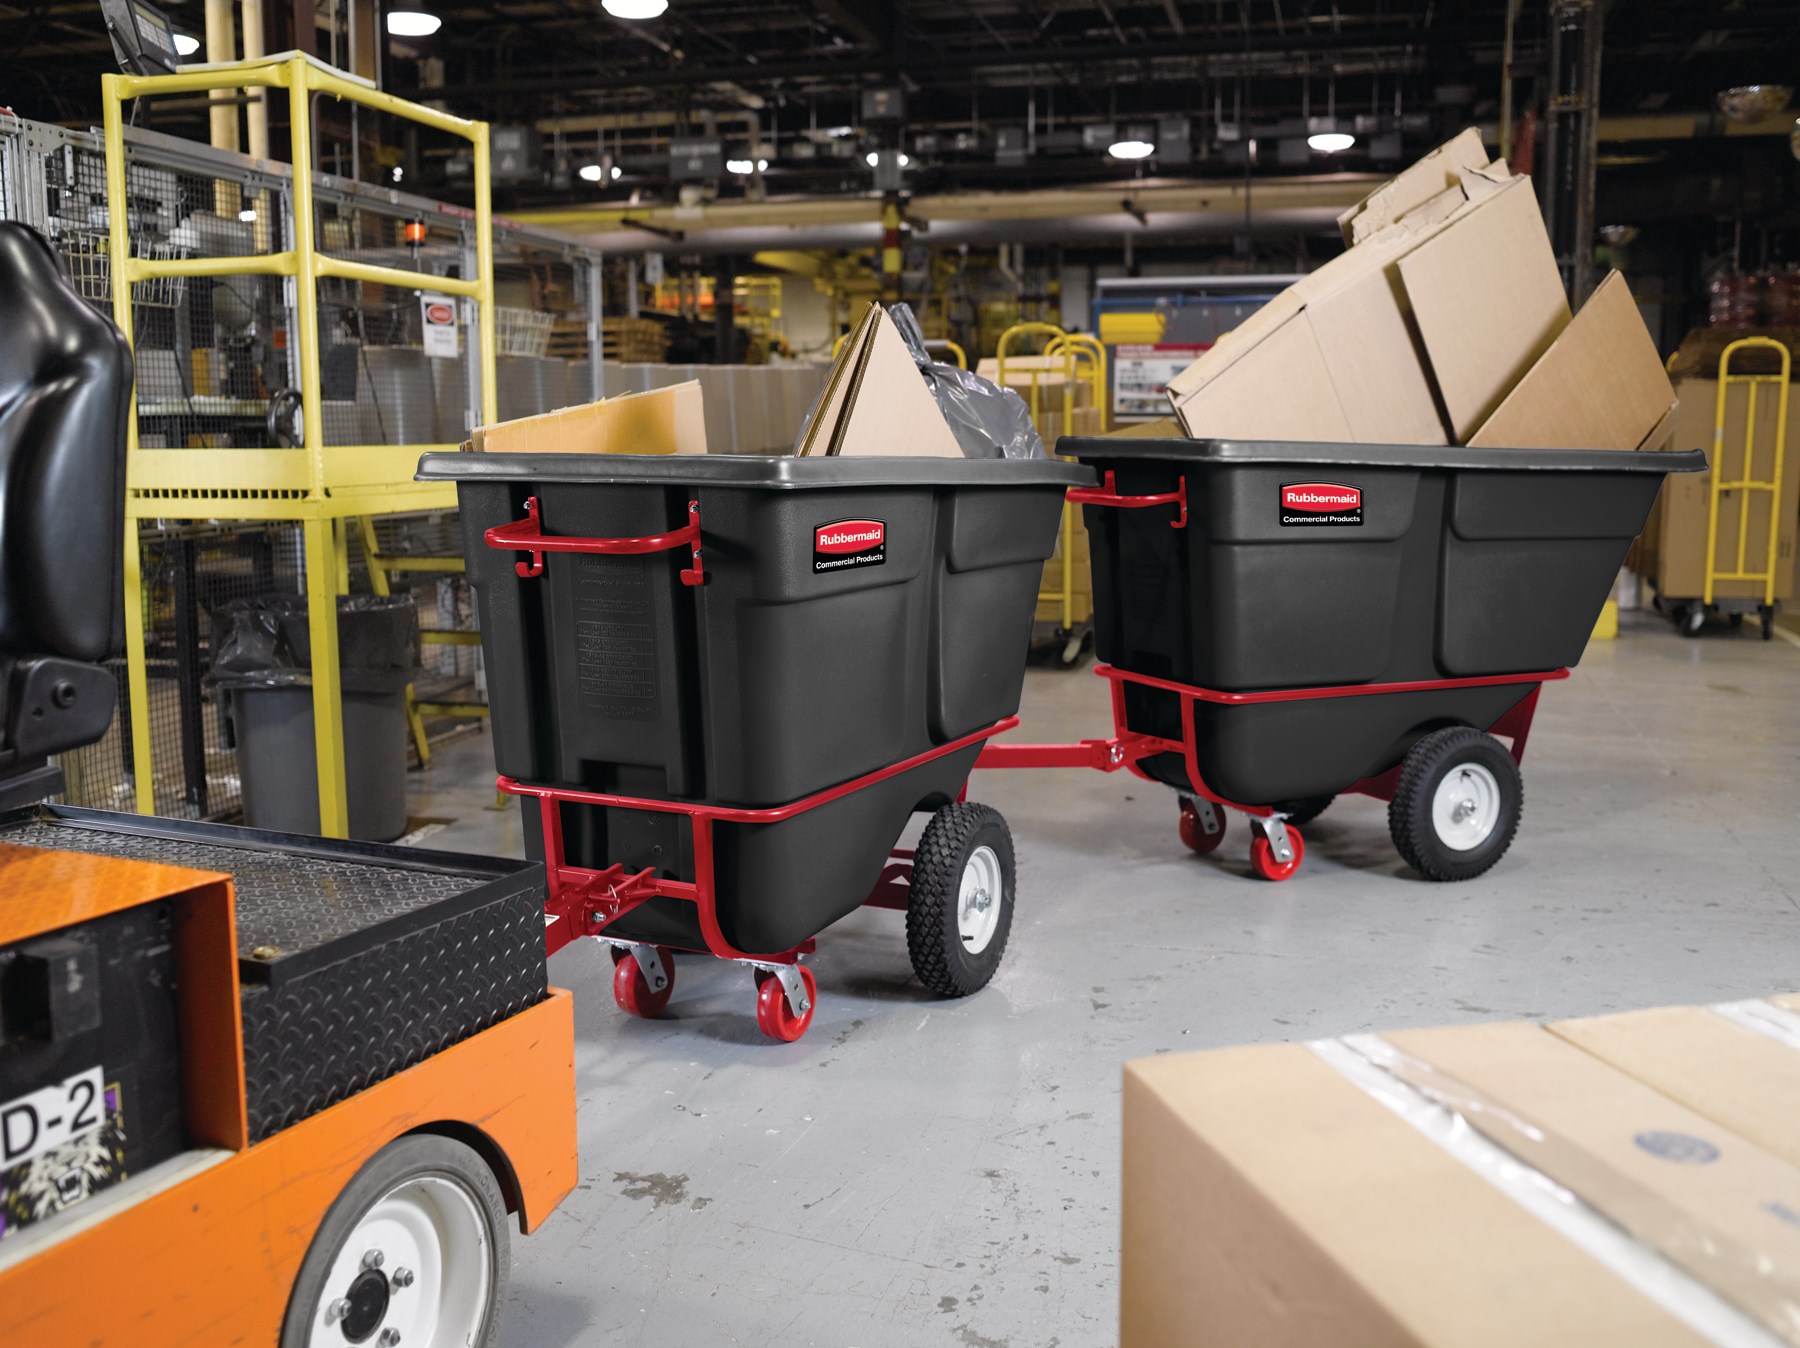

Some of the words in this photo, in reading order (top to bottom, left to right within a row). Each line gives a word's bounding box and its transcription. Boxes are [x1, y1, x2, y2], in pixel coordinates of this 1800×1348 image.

[1287, 493, 1357, 503] Rubbermaid
[820, 529, 881, 546] Rubbermaid
[816, 557, 855, 569] Commercial
[856, 554, 883, 564] Products
[1, 1079, 98, 1162] D-2
[474, 1166, 504, 1231] MONARCH
